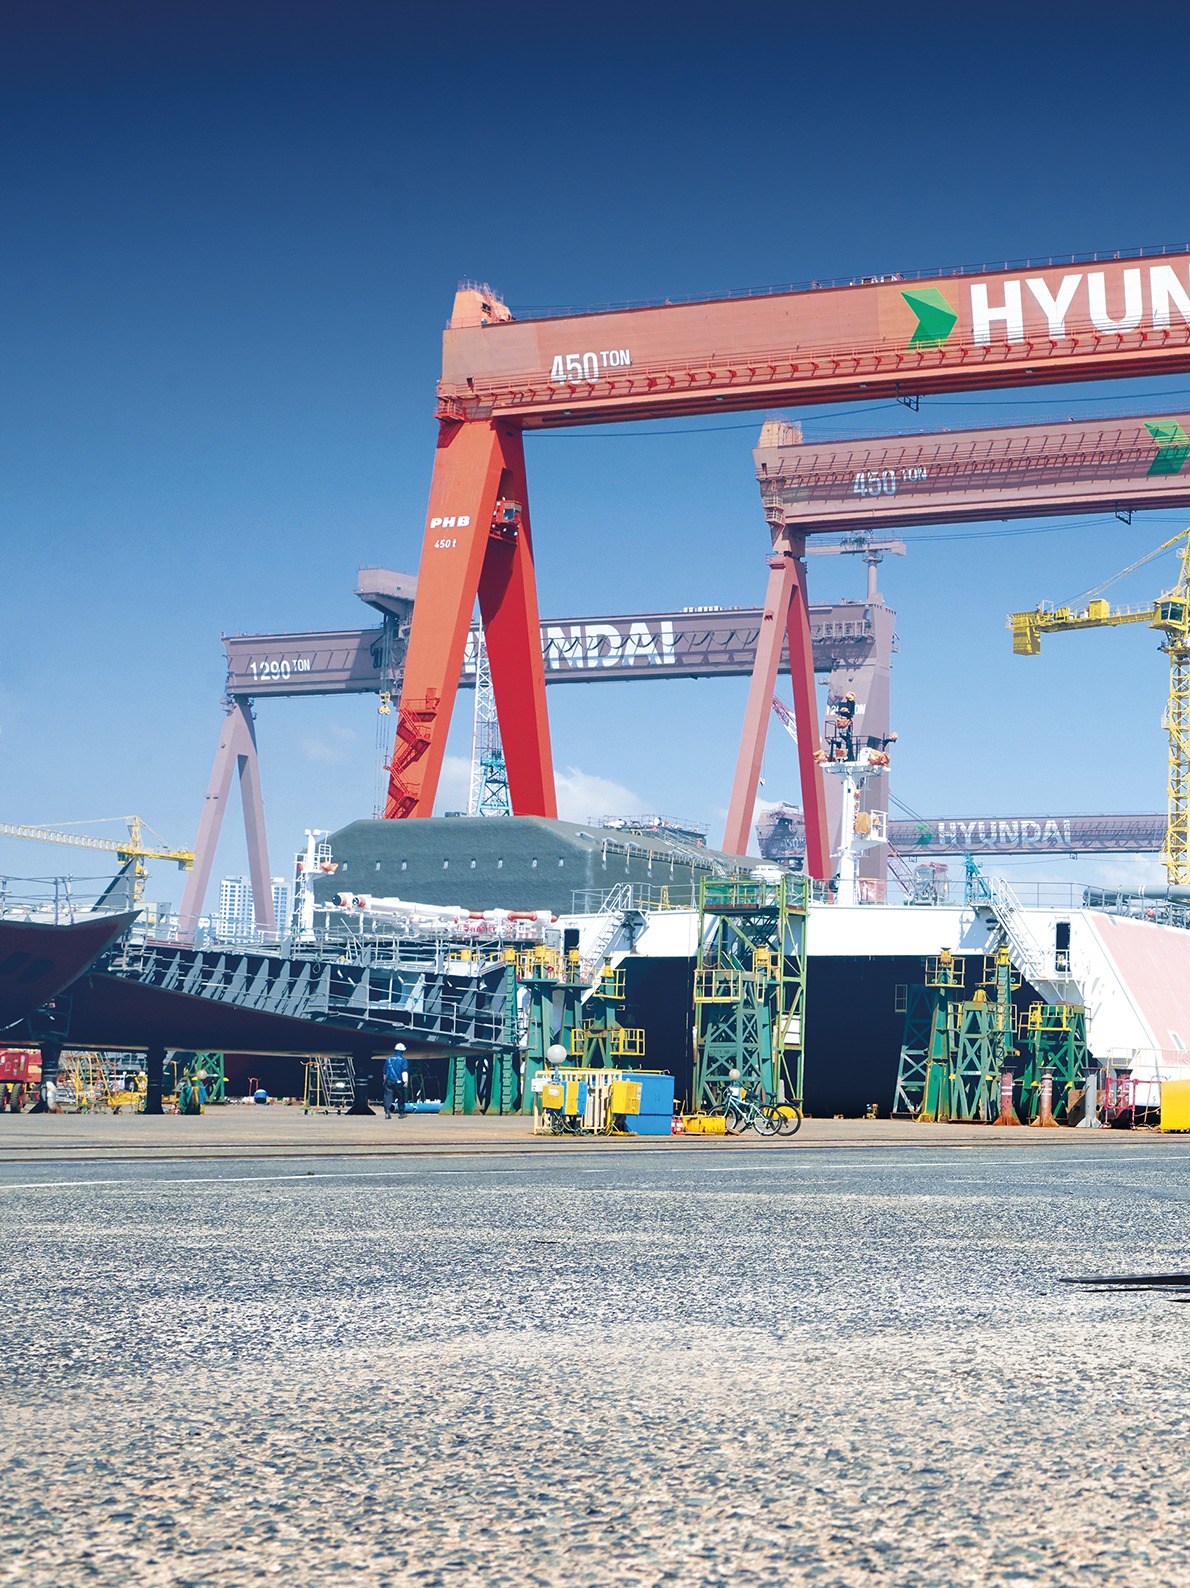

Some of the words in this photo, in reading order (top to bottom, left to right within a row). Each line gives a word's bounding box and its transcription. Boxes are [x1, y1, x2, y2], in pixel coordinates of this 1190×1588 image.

[550, 352, 600, 386] 450
[600, 349, 631, 368] TON
[853, 469, 897, 497] 450
[900, 466, 928, 482] TON
[430, 515, 471, 529] PHB
[434, 539, 451, 548] 450
[463, 621, 676, 674] NDAI
[250, 660, 291, 681] 1290
[292, 659, 311, 672] TON
[938, 819, 1071, 845] HYUNDAI
